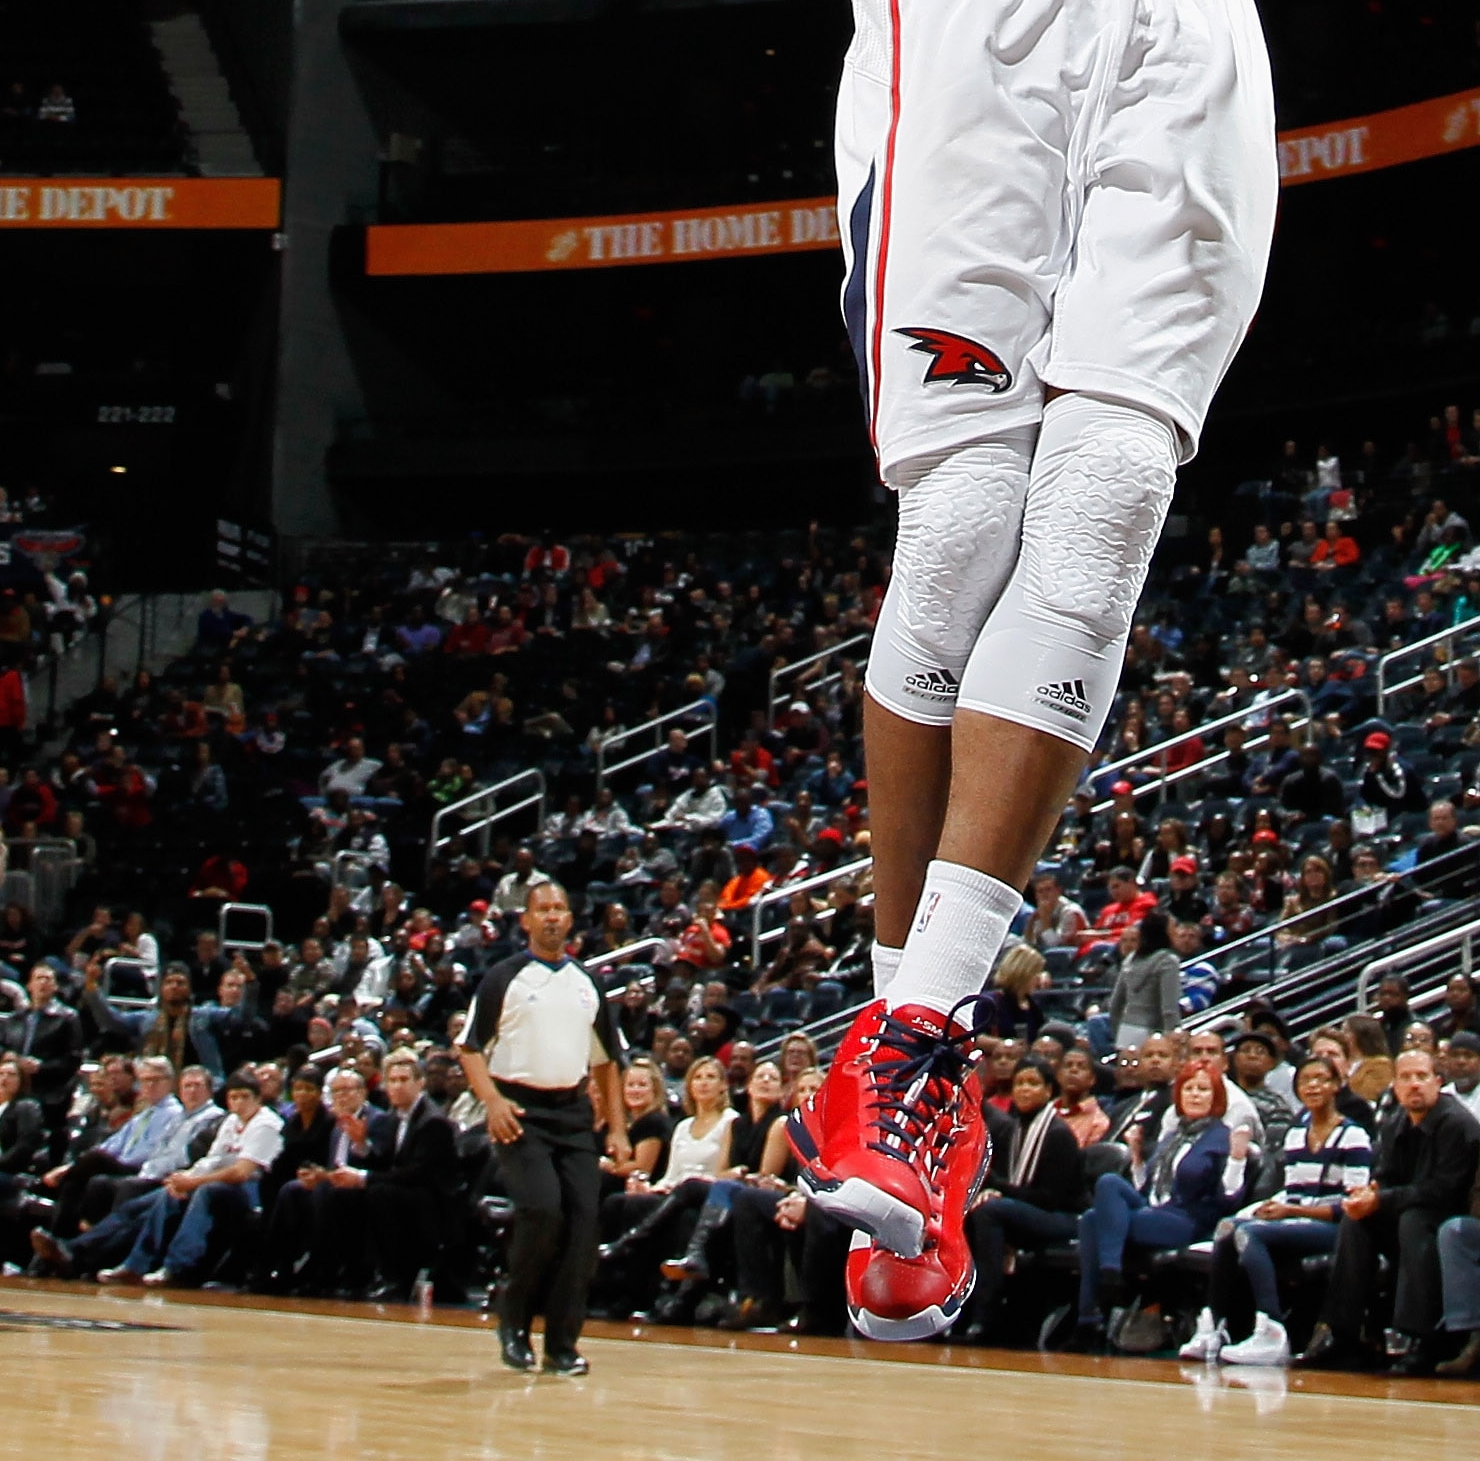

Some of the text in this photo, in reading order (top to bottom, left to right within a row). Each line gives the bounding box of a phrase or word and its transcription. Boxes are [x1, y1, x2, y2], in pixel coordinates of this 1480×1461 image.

[1277, 126, 1370, 180] EPOT
[38, 187, 175, 221] DEPOT
[582, 222, 664, 261] THE
[671, 210, 784, 255] HOME
[905, 675, 958, 694] adida
[1036, 685, 1092, 714] adidas
